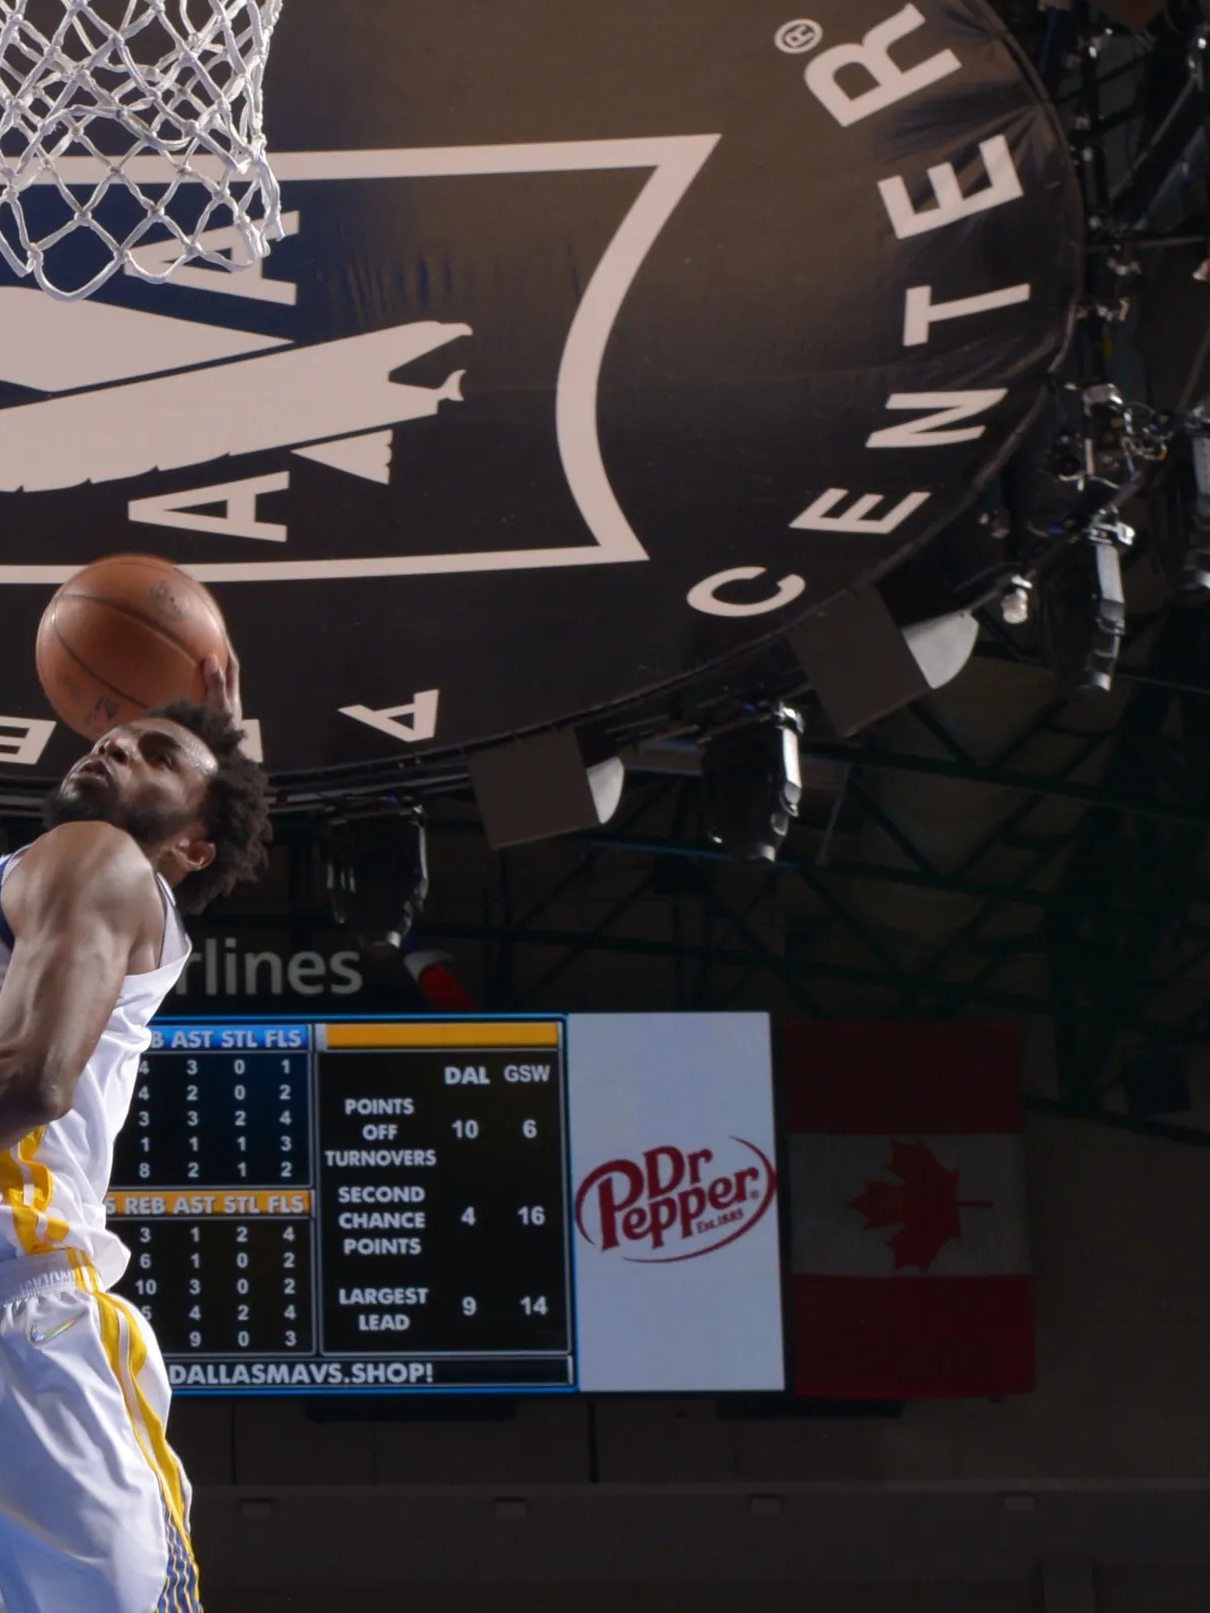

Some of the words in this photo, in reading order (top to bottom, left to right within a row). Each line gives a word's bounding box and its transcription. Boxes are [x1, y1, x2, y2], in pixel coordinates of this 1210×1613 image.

[175, 938, 363, 996] rlines
[170, 1030, 214, 1049] AST
[221, 1029, 258, 1048] STL
[265, 1029, 302, 1048] FLS
[138, 1060, 150, 1075] 4
[186, 1059, 198, 1076] 3
[233, 1058, 246, 1075] 0
[281, 1058, 290, 1074] 1
[444, 1066, 491, 1085] DAL
[503, 1064, 551, 1083] GSW
[137, 1085, 150, 1101] 4
[186, 1084, 199, 1101] 2
[233, 1084, 246, 1101] 0
[279, 1084, 291, 1100] 2
[345, 1097, 415, 1115] POINTS
[138, 1110, 150, 1127] 3
[187, 1110, 199, 1127] 3
[234, 1110, 247, 1127] 2
[279, 1110, 292, 1126] 4
[362, 1123, 398, 1141] OFF
[451, 1119, 479, 1139] 10
[522, 1119, 538, 1139] 6
[140, 1136, 150, 1153] 1
[189, 1136, 199, 1152] 1
[237, 1135, 246, 1152] 1
[280, 1135, 292, 1152] 3
[324, 1149, 437, 1167] TURNOVERS
[138, 1162, 151, 1179] 8
[187, 1161, 200, 1178] 2
[237, 1161, 247, 1178] 1
[280, 1161, 293, 1178] 2
[642, 1145, 714, 1200] Dr
[338, 1185, 426, 1204] SECOND
[124, 1196, 166, 1215] REB
[173, 1195, 215, 1214] AST
[223, 1195, 260, 1214] STL
[267, 1195, 305, 1214] FLS
[577, 1159, 760, 1252] Pepper
[338, 1211, 426, 1230] CHANCE
[461, 1206, 477, 1226] 4
[517, 1205, 546, 1226] 16
[139, 1226, 152, 1244] 3
[190, 1226, 200, 1243] 1
[236, 1225, 248, 1243] 2
[282, 1225, 295, 1242] 4
[343, 1237, 422, 1256] POINTS
[139, 1252, 152, 1269] 6
[190, 1252, 200, 1269] 1
[236, 1252, 249, 1269] 0
[283, 1251, 295, 1269] 2
[134, 1278, 157, 1296] 10
[189, 1278, 201, 1296] 3
[236, 1278, 249, 1295] 0
[283, 1277, 296, 1295] 2
[338, 1287, 429, 1305] LARGEST
[188, 1305, 202, 1321] 4
[237, 1304, 249, 1321] 2
[283, 1304, 297, 1320] 4
[462, 1296, 477, 1317] 9
[520, 1295, 548, 1316] 14
[358, 1313, 411, 1331] LEAD
[189, 1331, 202, 1348] 9
[237, 1330, 250, 1348] 0
[285, 1330, 297, 1347] 3
